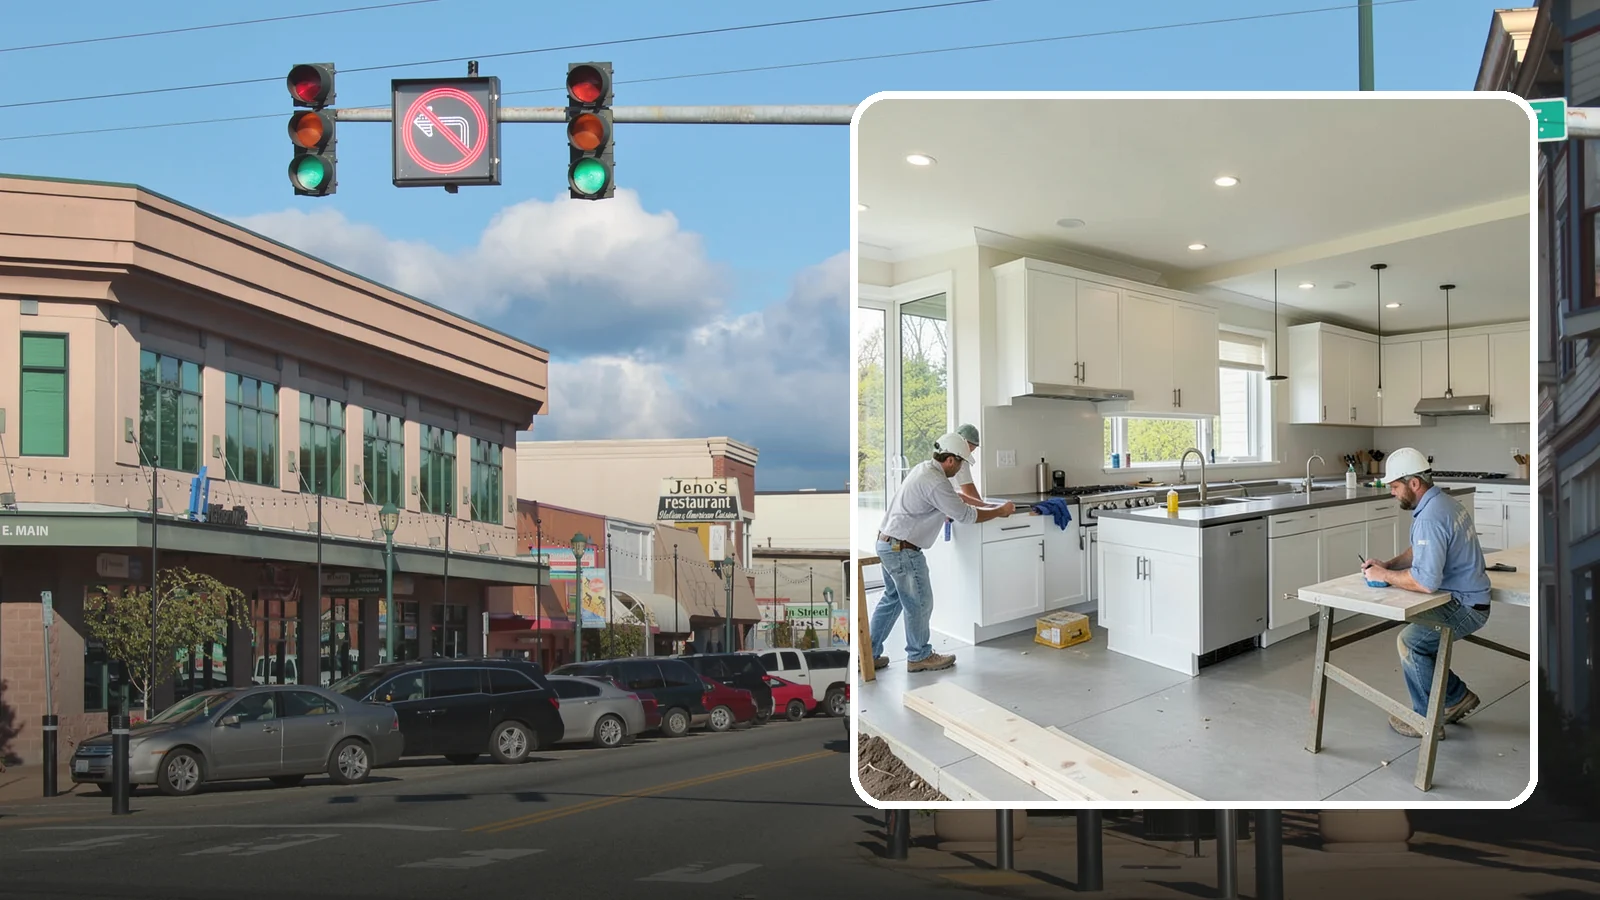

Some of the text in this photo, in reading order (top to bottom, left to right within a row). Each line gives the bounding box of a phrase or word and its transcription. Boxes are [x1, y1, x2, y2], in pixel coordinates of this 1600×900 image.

[669, 480, 727, 494] Jeno's
[665, 496, 731, 509] restaurant
[658, 509, 681, 520] Italian
[685, 509, 714, 519] American
[715, 509, 737, 519] Cuisine
[2, 525, 49, 536] E. MAIN
[797, 607, 829, 617] Street
